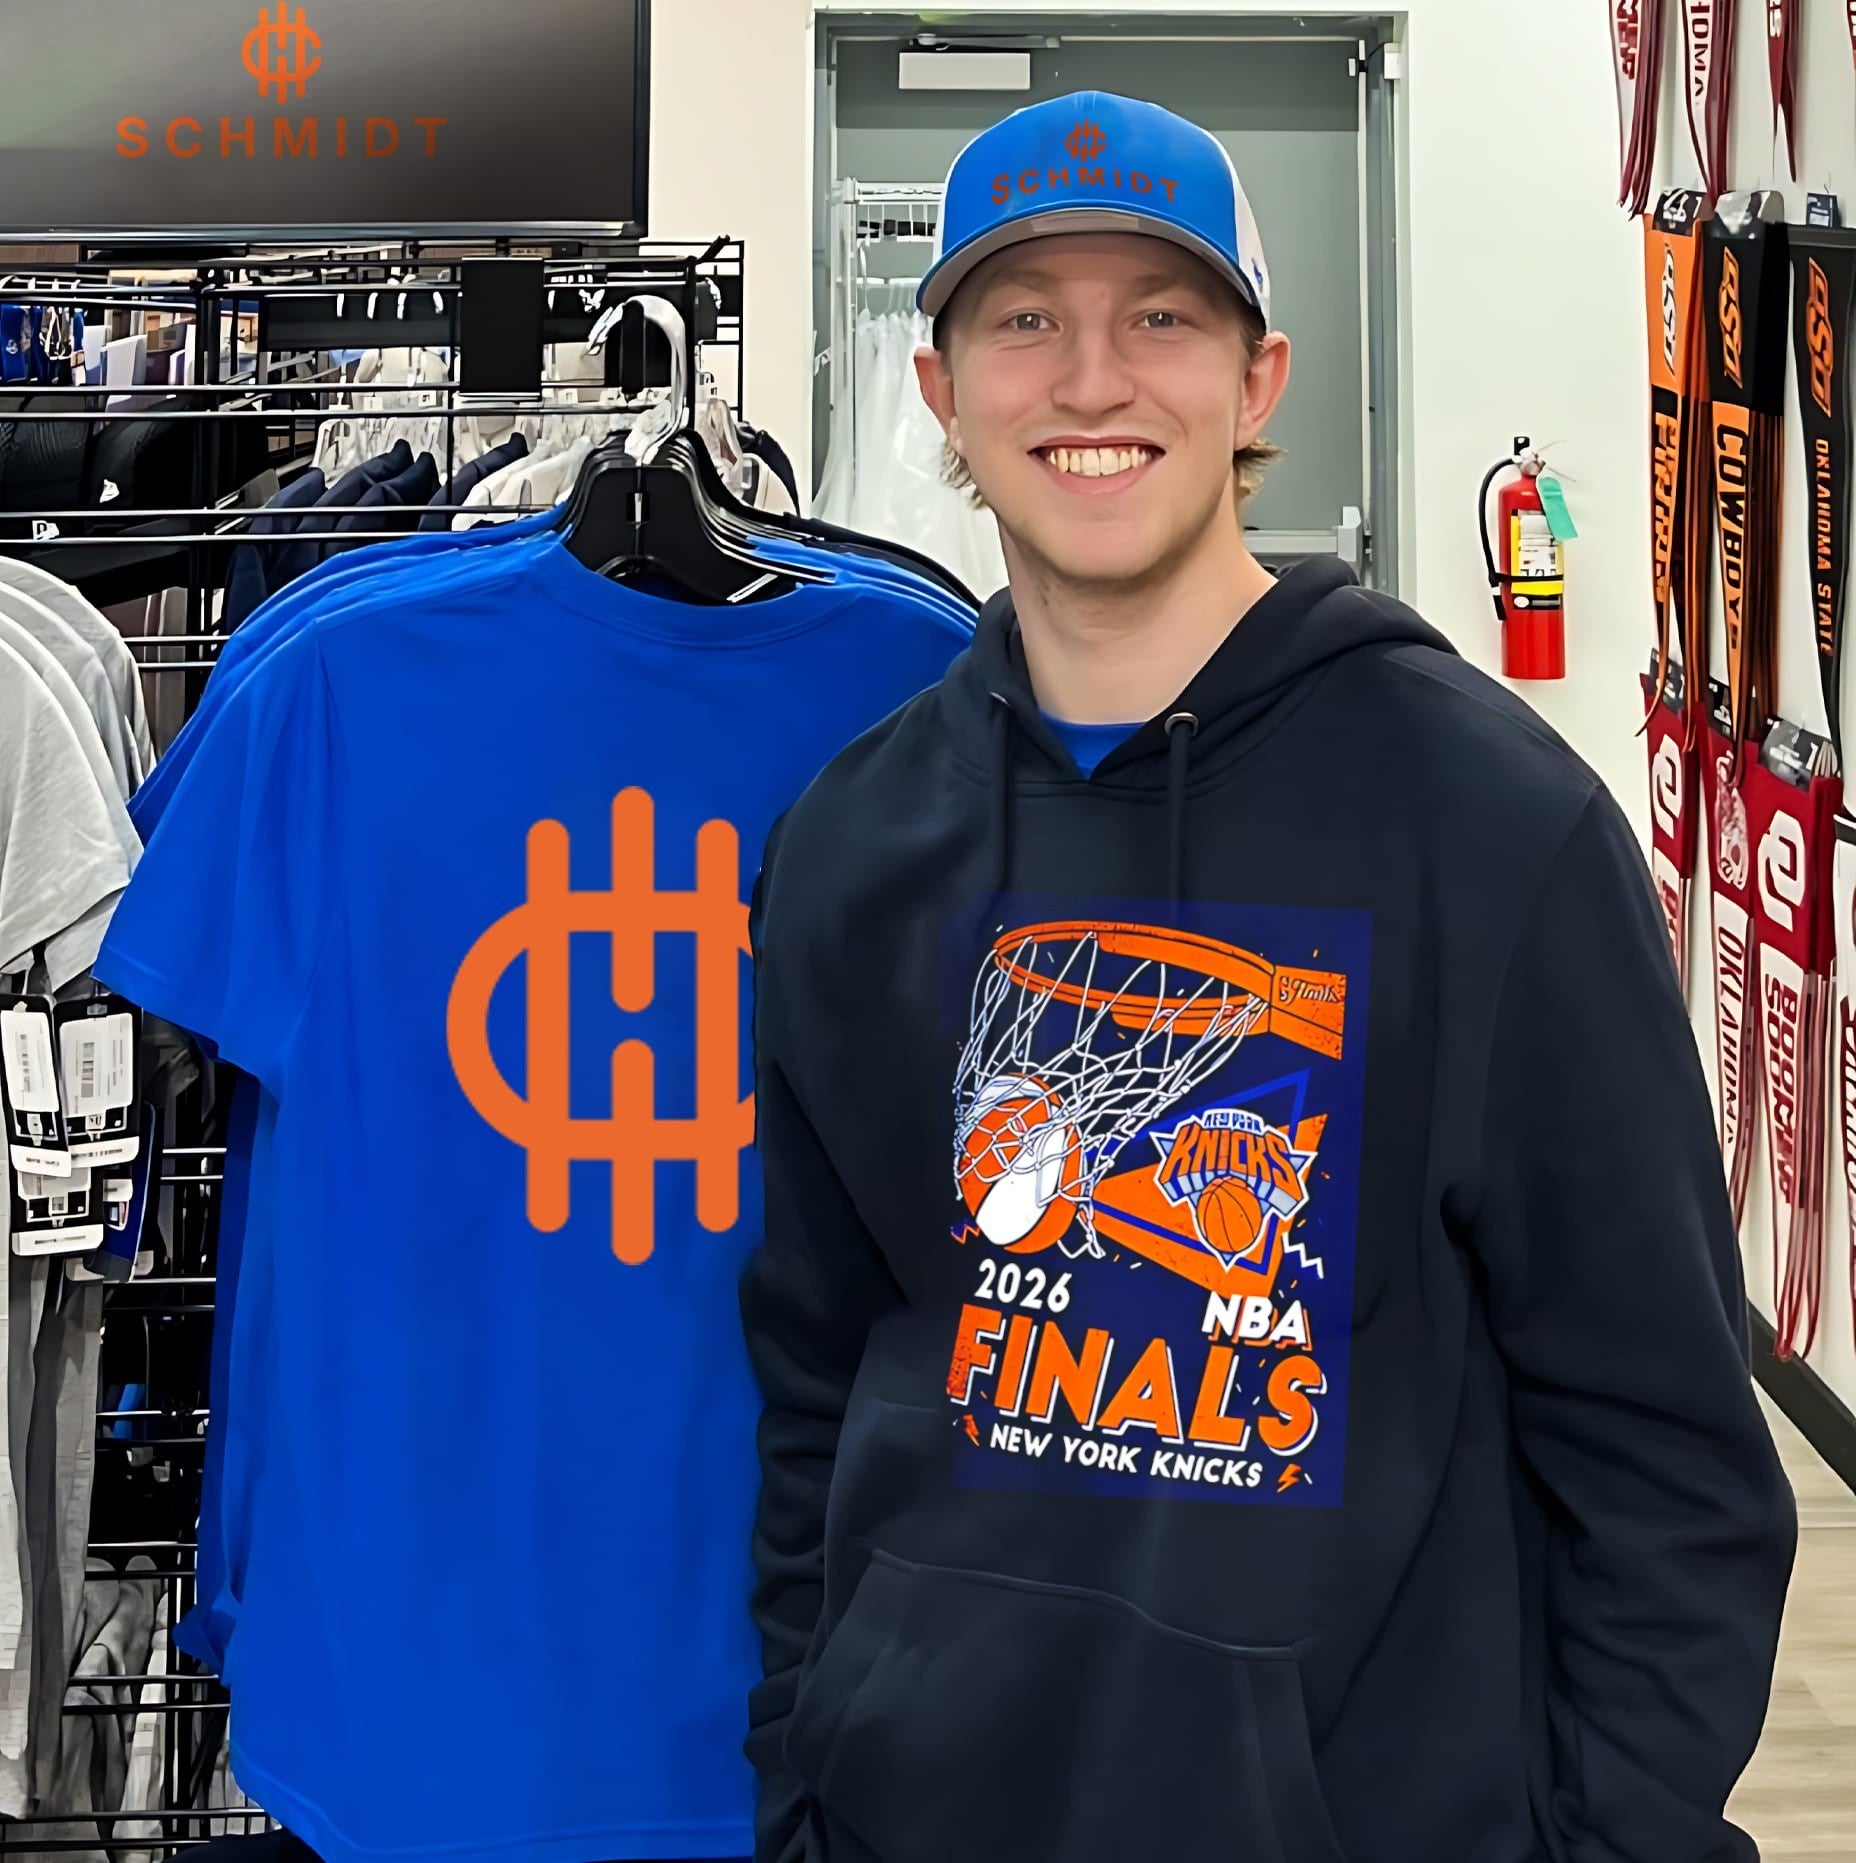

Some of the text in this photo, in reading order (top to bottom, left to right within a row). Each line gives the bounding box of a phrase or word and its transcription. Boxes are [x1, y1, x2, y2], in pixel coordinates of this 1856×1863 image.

[115, 116, 447, 158] SCHMIDT
[991, 167, 1179, 204] SCHMIDT
[1815, 438, 1832, 570] OKLAHOMA
[1719, 927, 1746, 1144] OKLAHOMA
[1166, 1122, 1304, 1200] KNICKS
[974, 1258, 1072, 1313] 2026
[1201, 1293, 1312, 1350] NBA
[946, 1303, 1328, 1456] FINALS
[989, 1422, 1264, 1488] NEW YORK KNICKS
